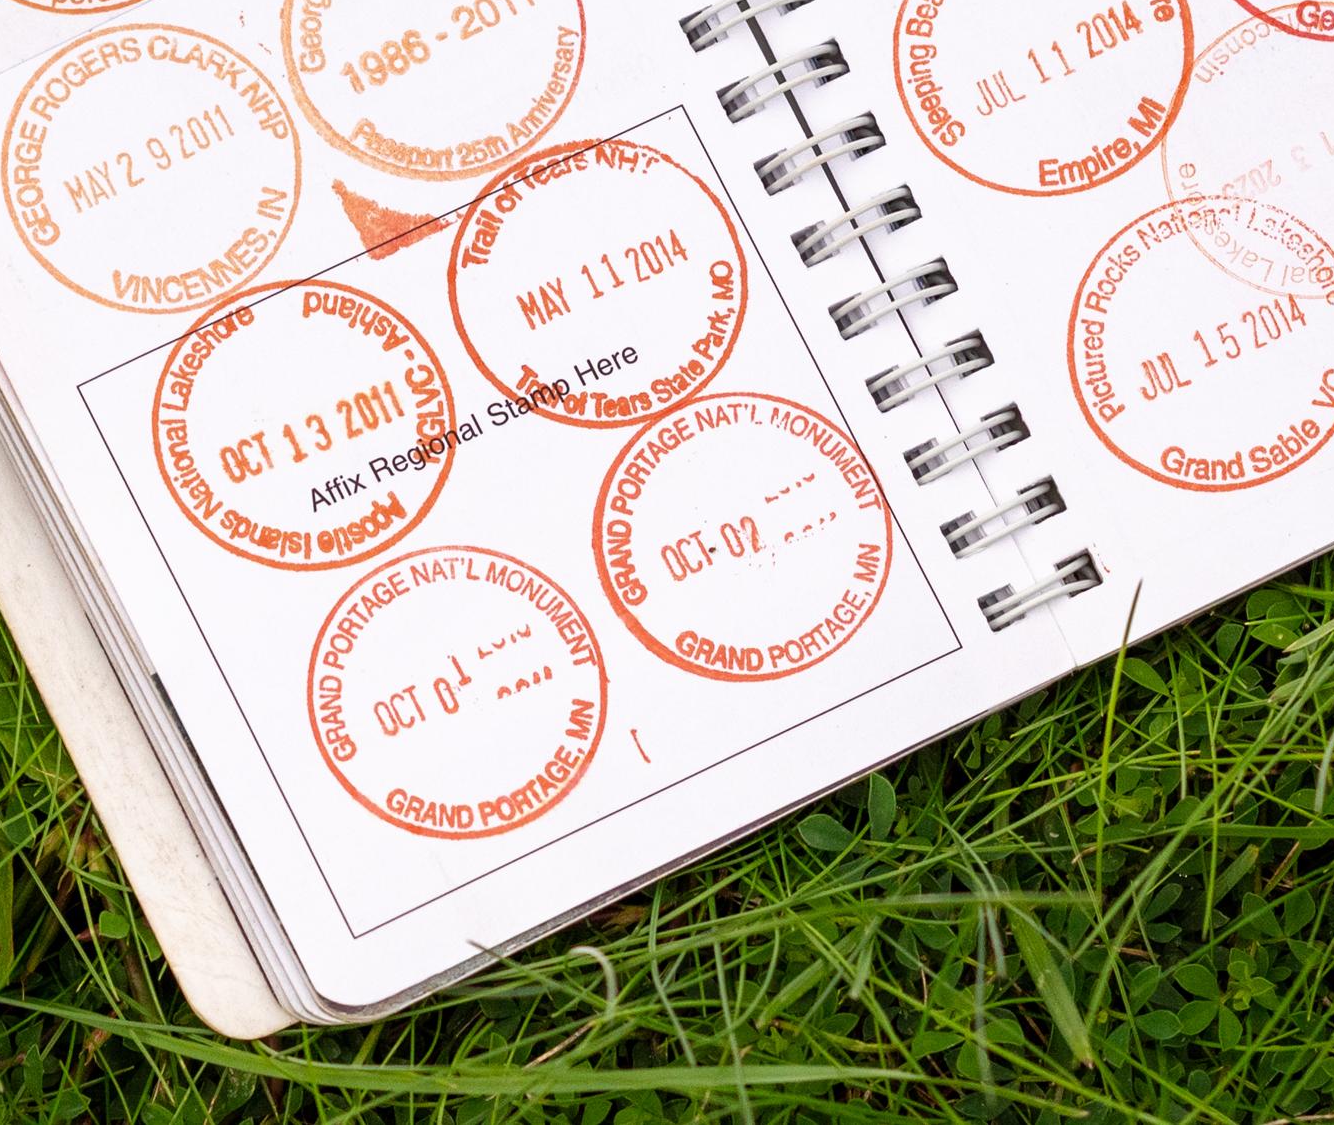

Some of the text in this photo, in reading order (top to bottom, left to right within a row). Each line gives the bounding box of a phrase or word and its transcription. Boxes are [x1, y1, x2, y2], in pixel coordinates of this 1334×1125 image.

[340, 29, 431, 94] 1986
[506, 25, 579, 146] Anniversary
[907, 43, 965, 147] Sleeping
[977, 70, 1026, 116] JUL
[1077, 0, 1143, 58] 2014
[14, 35, 289, 246] GEORGE ROGERS CLARK NHP
[64, 105, 234, 213] MAY 2011
[1039, 96, 1165, 187] Empire, MI
[112, 186, 287, 303] VINCENNES, IN
[462, 209, 503, 268] Trail
[494, 181, 523, 213] of
[303, 291, 409, 351] Ashland
[516, 277, 570, 330] MAY
[625, 229, 688, 282] 2014
[1084, 245, 1141, 314] Rocks
[567, 260, 736, 418] of Tears State Park, MO
[1081, 319, 1125, 423] Pictured
[1140, 352, 1191, 401] JUL
[1242, 293, 1306, 348] 2014
[160, 306, 407, 559] Apostle Islands National Lakeshore
[219, 431, 274, 483] OCT
[336, 380, 404, 439] 2011
[310, 346, 639, 512] Affix Regional Stamp Here
[611, 418, 694, 516] PORTAGE
[770, 407, 882, 510] MONUMENT
[1160, 445, 1245, 480] Grand
[1248, 419, 1321, 472] Sable
[410, 557, 480, 586] NAT'L
[607, 519, 647, 606] GRAND
[661, 530, 713, 581] OCT
[675, 543, 880, 671] GRAND PORTAGE, MN
[323, 572, 410, 670] PORTAGE
[485, 562, 597, 667] MONUMENT
[319, 675, 357, 762] GRAND
[374, 685, 426, 736] OCT
[386, 698, 594, 829] GRAND PORTAGE, MN
